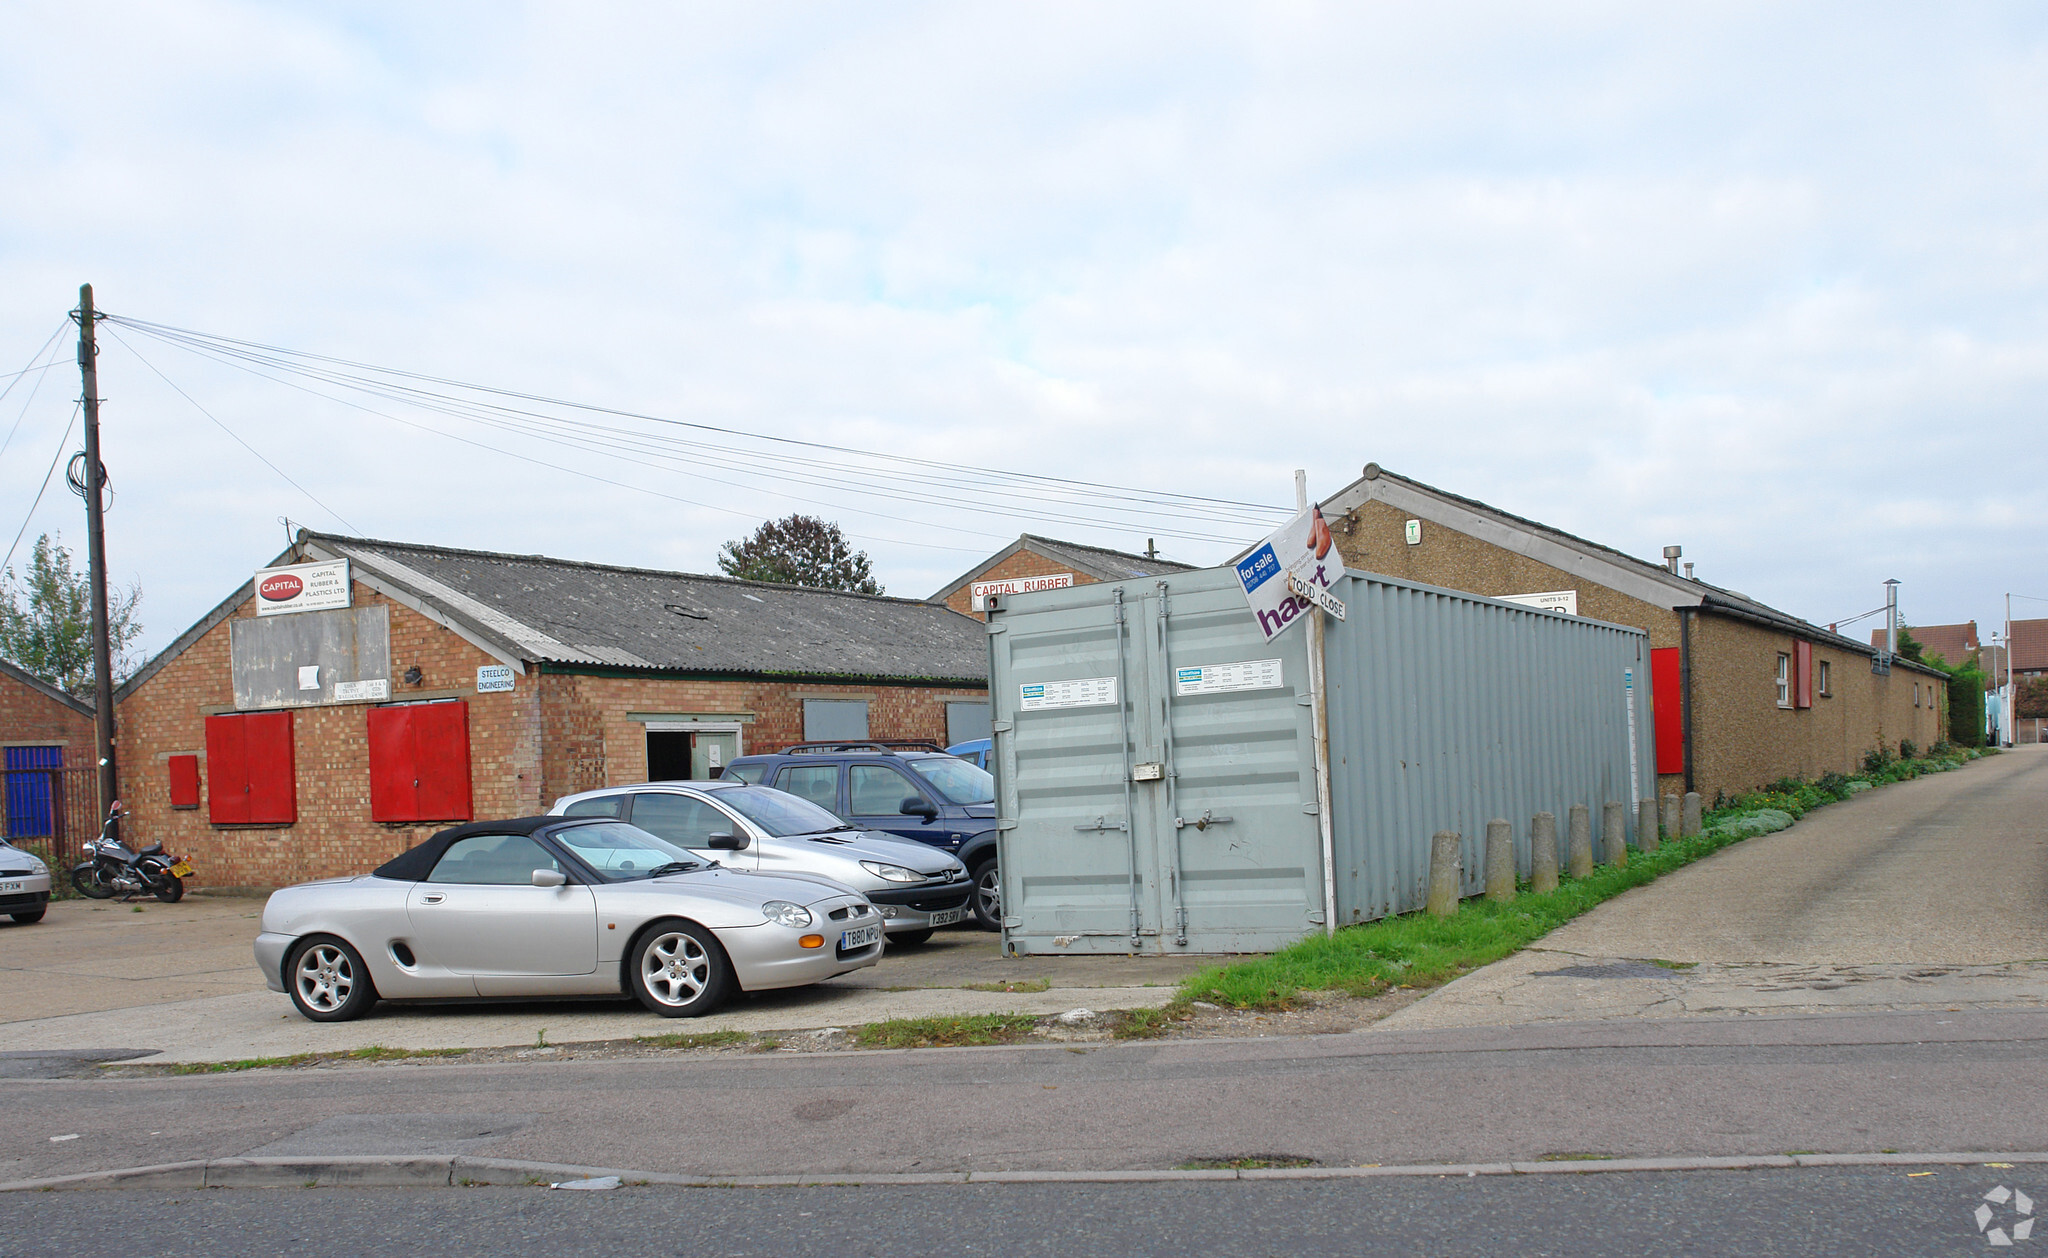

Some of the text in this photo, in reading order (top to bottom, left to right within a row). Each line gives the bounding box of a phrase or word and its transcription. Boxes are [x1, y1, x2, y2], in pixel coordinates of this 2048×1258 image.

[1240, 553, 1274, 581] for sale
[262, 580, 300, 592] CAPITAL
[975, 578, 1068, 596] CAPITAL RUBBER
[1292, 577, 1343, 617] TODD CLOSE
[482, 669, 509, 678] STEELCO
[479, 680, 513, 689] ENGINEERING
[932, 910, 960, 925] Y392 SRV
[847, 926, 879, 946] T880 NPU
